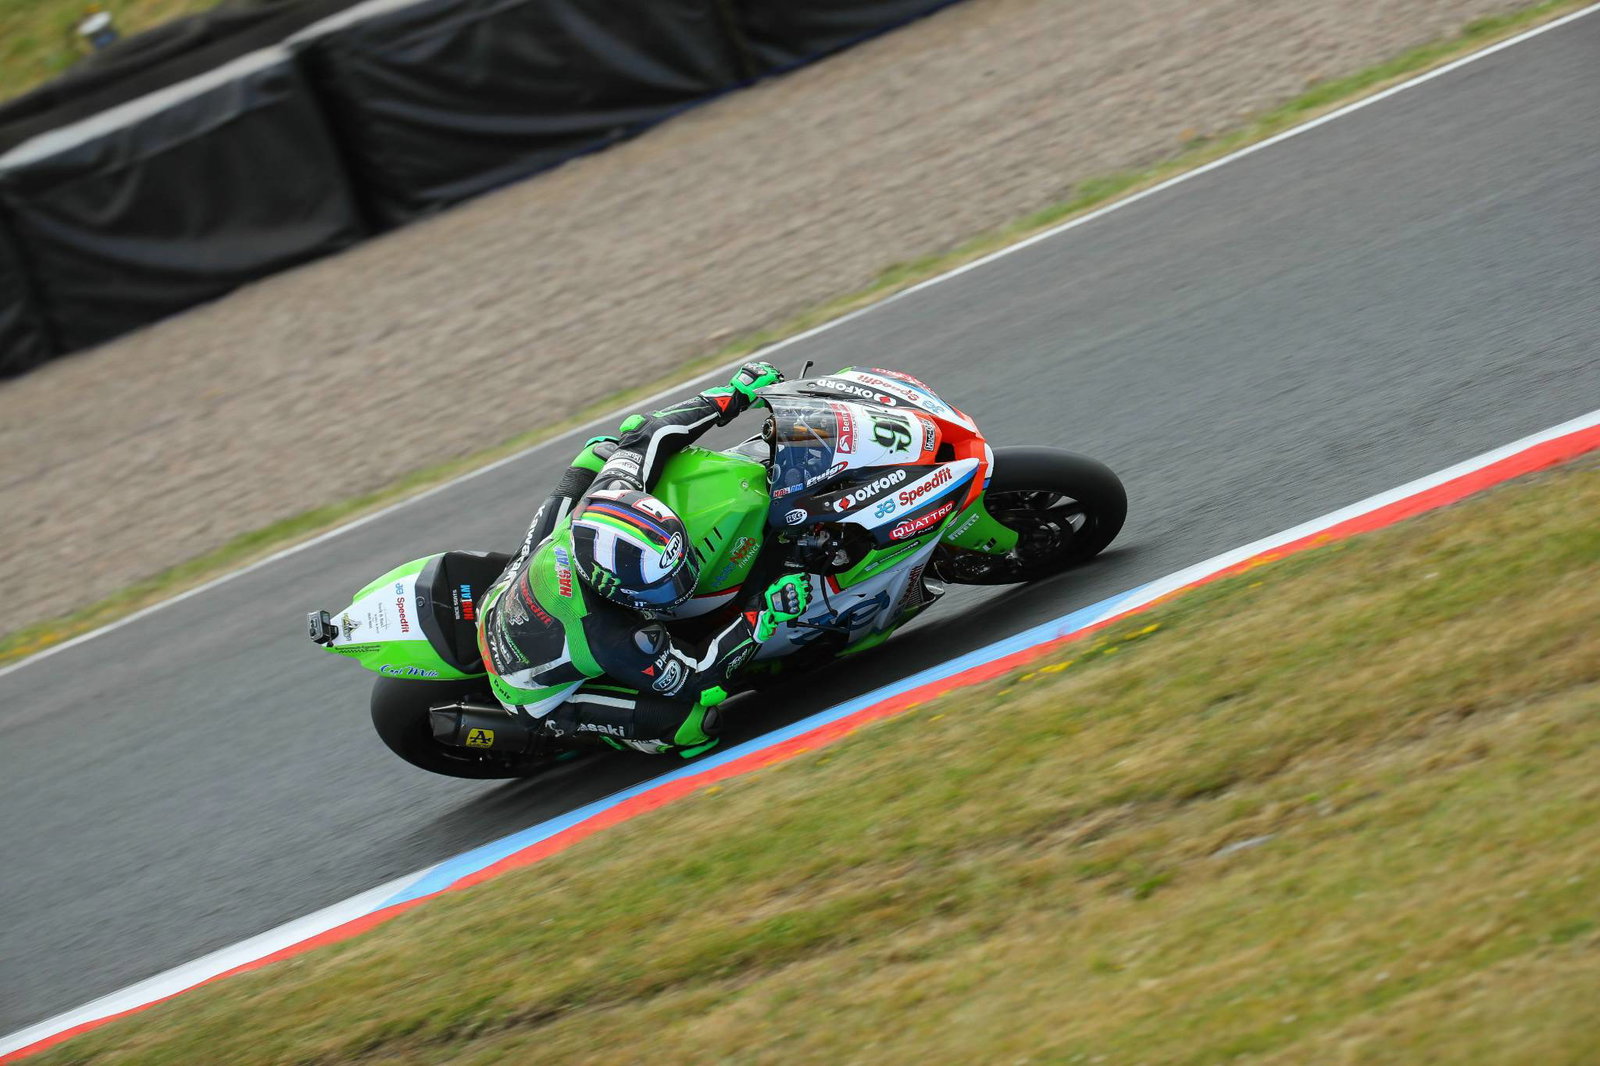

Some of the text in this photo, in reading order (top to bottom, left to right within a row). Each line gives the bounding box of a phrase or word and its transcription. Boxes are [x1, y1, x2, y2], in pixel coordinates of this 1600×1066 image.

[816, 379, 874, 398] OXFORD
[855, 469, 907, 501] OXFORD
[899, 467, 953, 506] Speedfit
[892, 503, 954, 538] QUATTRO
[396, 597, 410, 633] Speedfit
